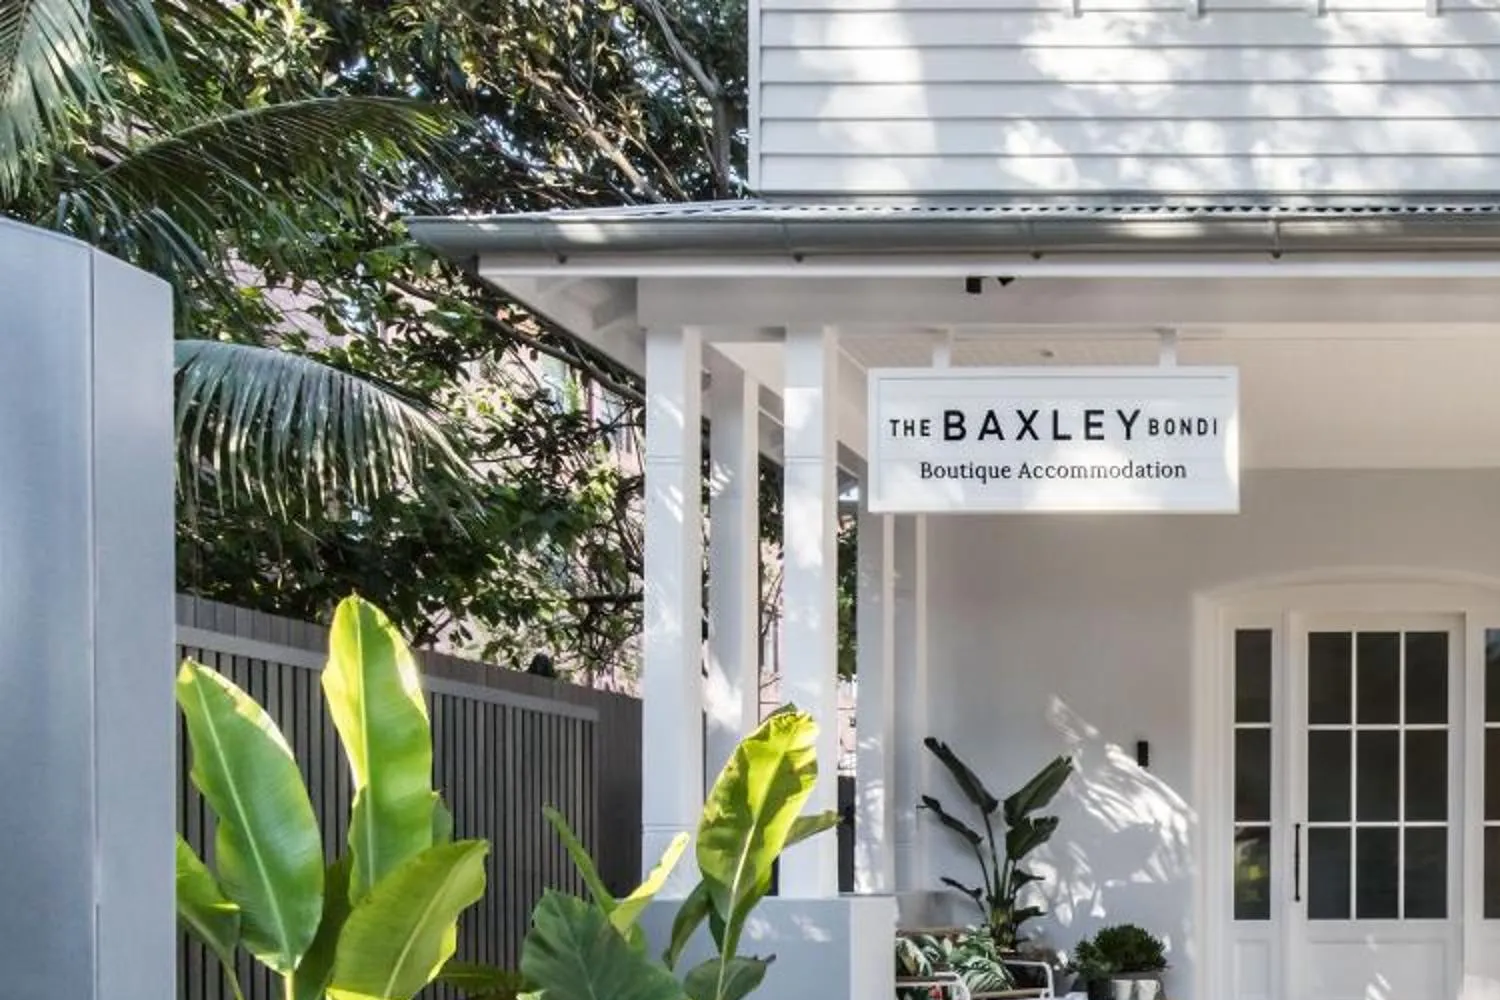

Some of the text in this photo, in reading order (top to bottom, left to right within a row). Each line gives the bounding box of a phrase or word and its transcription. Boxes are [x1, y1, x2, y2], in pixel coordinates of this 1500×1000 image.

[889, 409, 1217, 441] THE BAXLEY BONDI
[920, 460, 1187, 484] Boutique Accommodation
